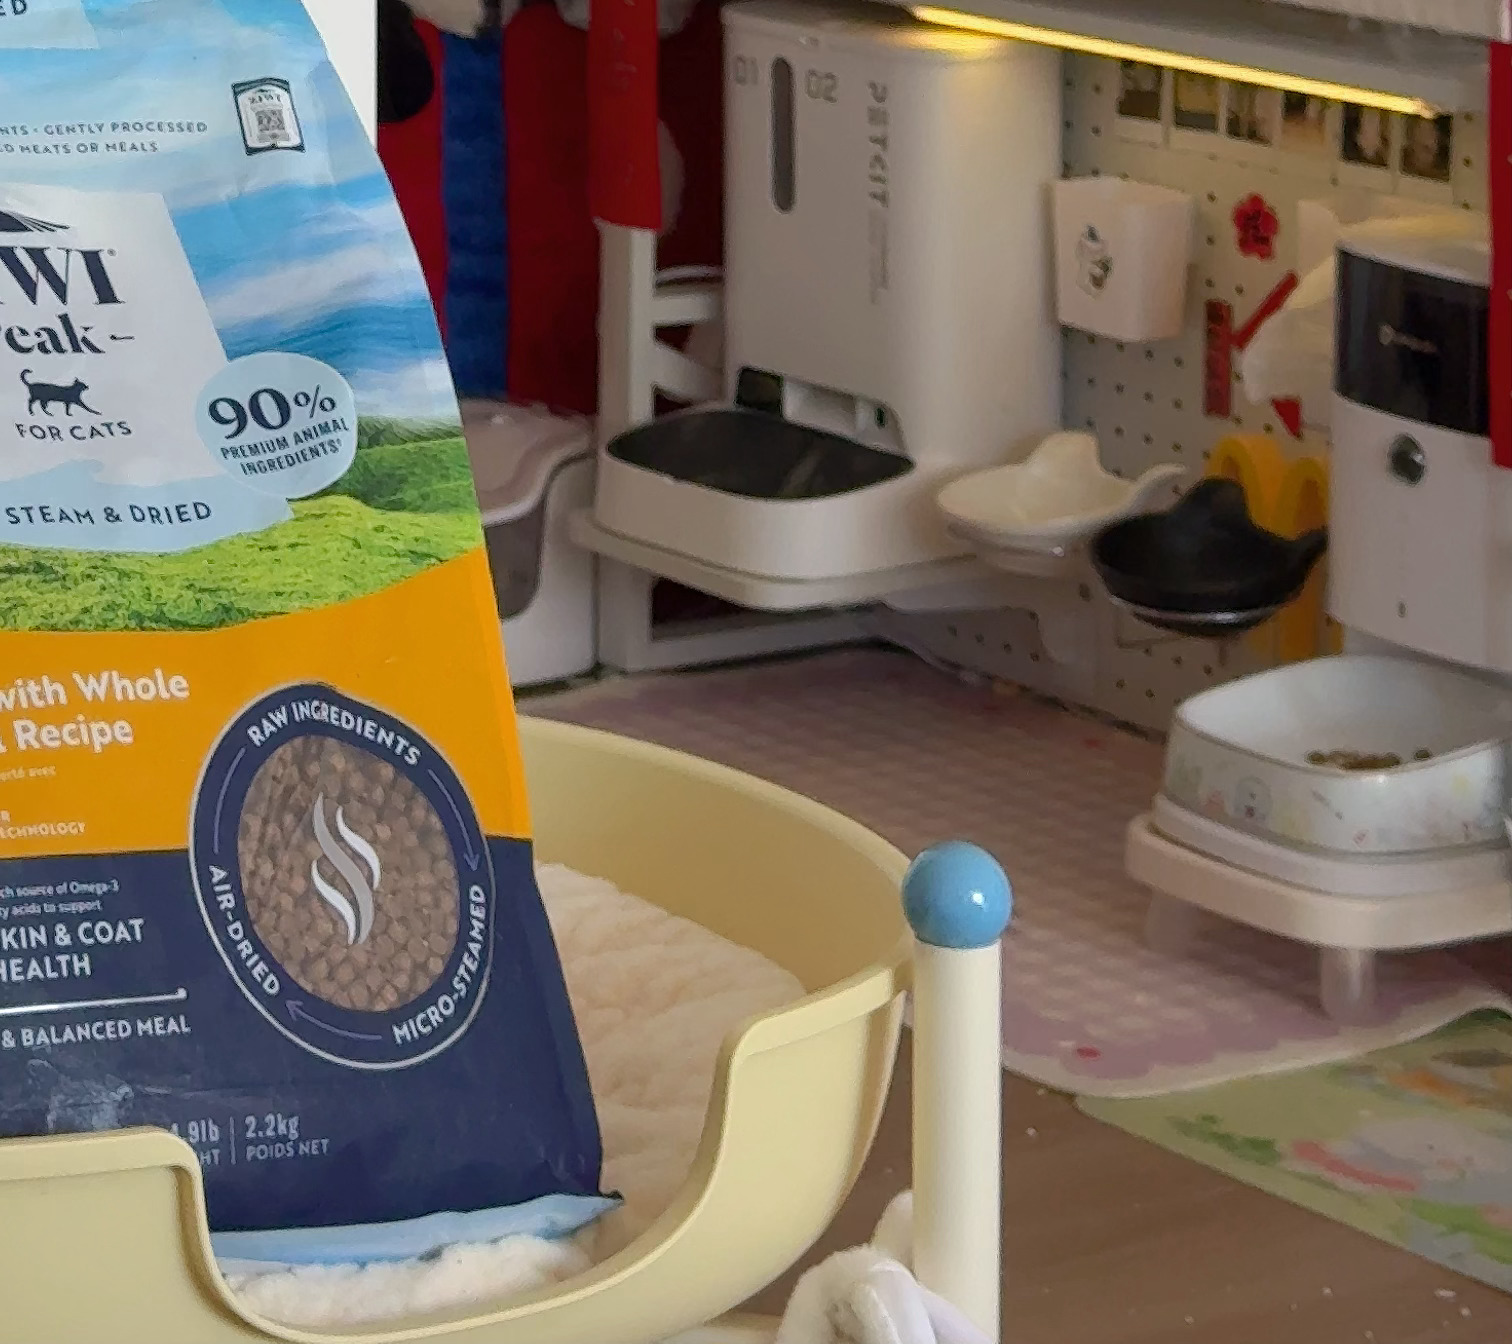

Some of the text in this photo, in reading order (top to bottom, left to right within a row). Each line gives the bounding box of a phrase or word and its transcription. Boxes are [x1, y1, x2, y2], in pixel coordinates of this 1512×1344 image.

[43, 122, 105, 137] GENTLY
[109, 120, 209, 134] PROCESSED
[19, 142, 71, 155] MEATS
[76, 141, 99, 154] OR
[105, 141, 160, 153] MEALS
[207, 383, 337, 441] 90%
[14, 420, 133, 443] FOR CATS
[219, 416, 351, 462] PREMIUM ANIMAL
[4, 500, 213, 526] STEAM & DRIED
[71, 666, 192, 704] Whole
[11, 712, 135, 755] Recipe
[246, 697, 423, 767] RAW INGREDIENTS
[53, 921, 73, 947] &
[76, 916, 145, 947] COAT
[207, 864, 282, 996] AIR-DRIED
[391, 883, 488, 1047] MICRO-STEAMED
[0, 1027, 17, 1050] &
[20, 1018, 133, 1050] BALANCED
[137, 1014, 193, 1038] MEAL
[244, 1111, 300, 1141] 2.2kg
[245, 1139, 295, 1162] POIDS
[297, 1137, 331, 1156] NET
